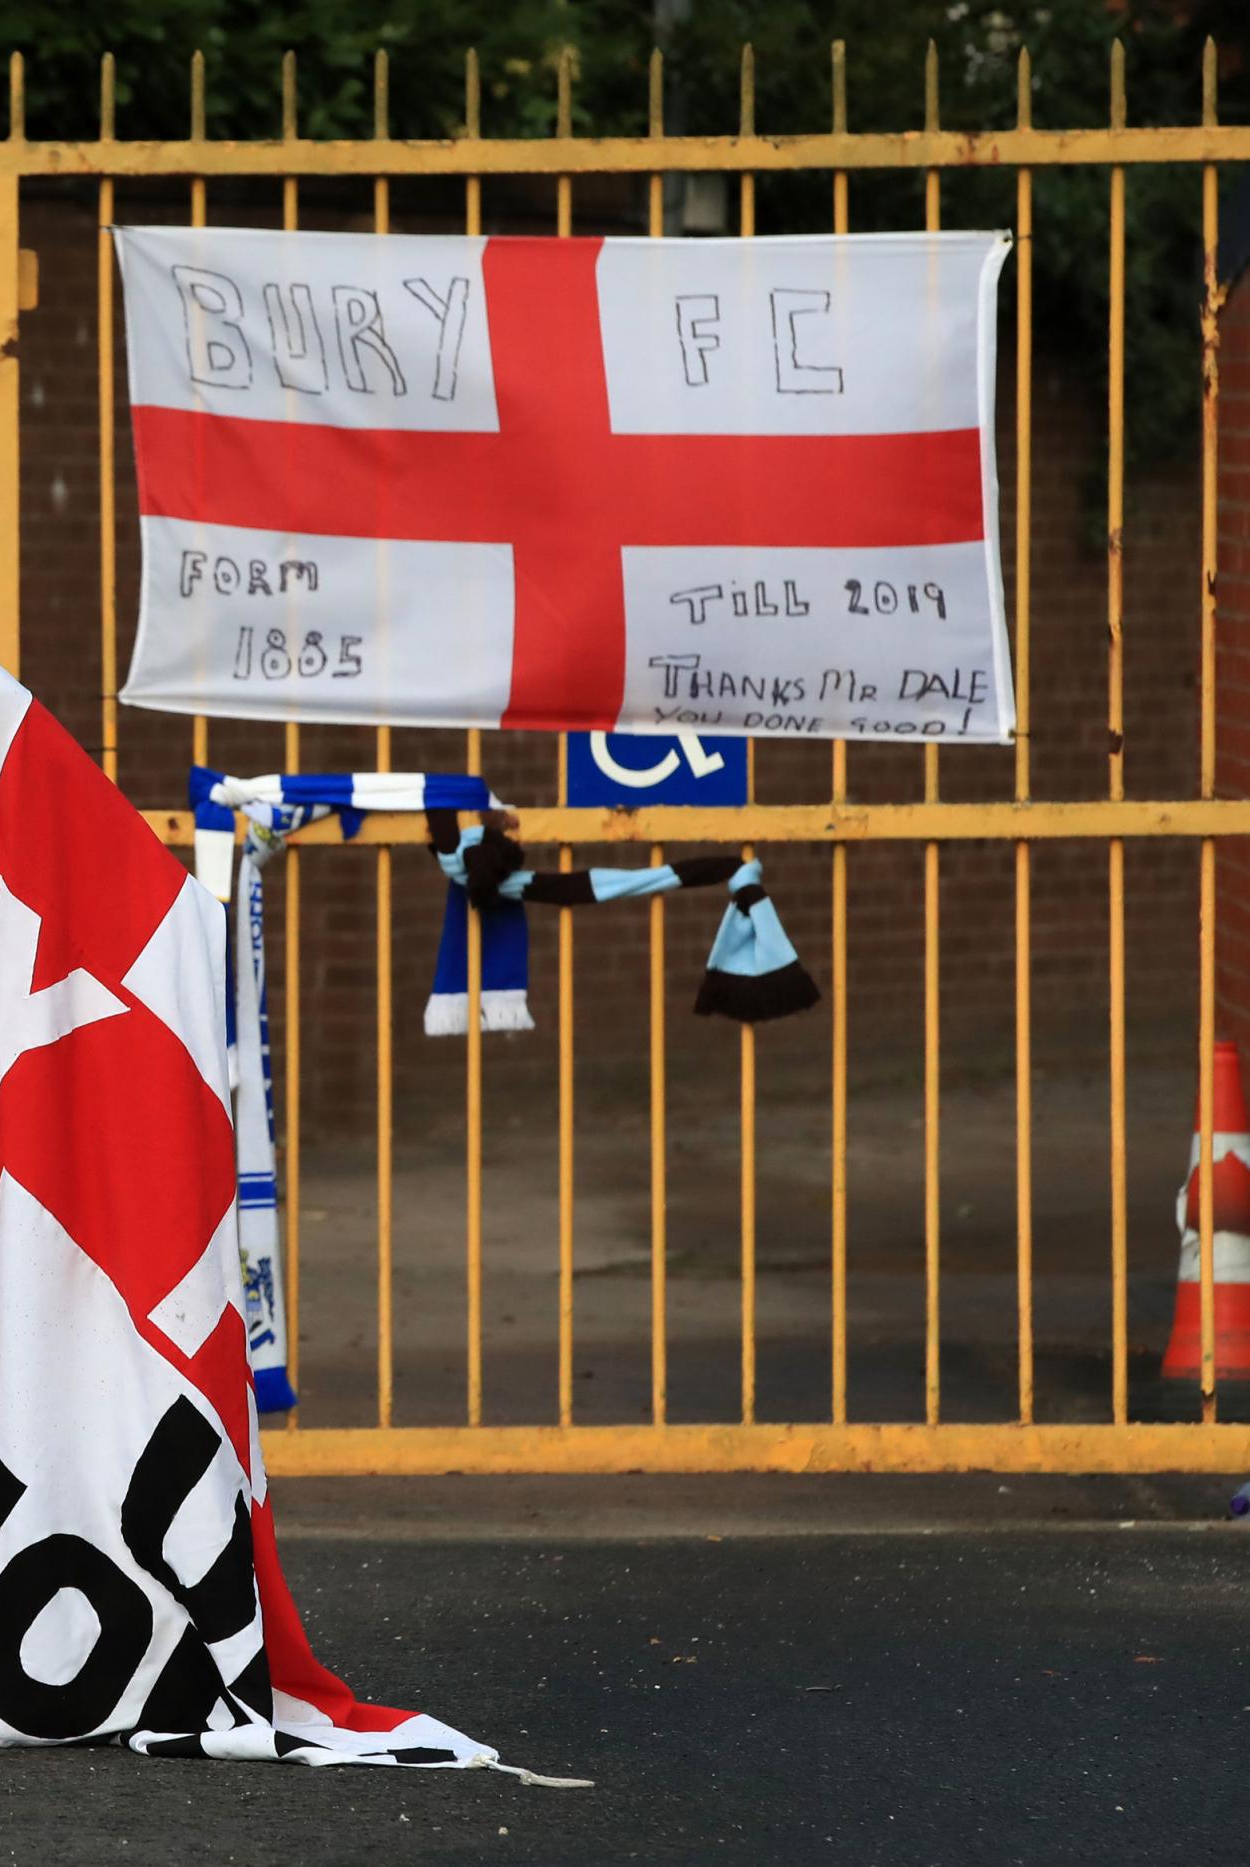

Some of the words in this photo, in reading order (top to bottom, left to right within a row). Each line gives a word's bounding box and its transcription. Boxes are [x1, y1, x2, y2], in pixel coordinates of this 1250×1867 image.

[171, 265, 470, 401] BURY
[179, 549, 319, 599] FORM
[844, 579, 947, 620] 2019
[233, 626, 363, 680] 1885
[648, 652, 806, 706] THANKS
[900, 667, 990, 704] DALE
[653, 704, 722, 726] YOU
[744, 712, 826, 732] DONE
